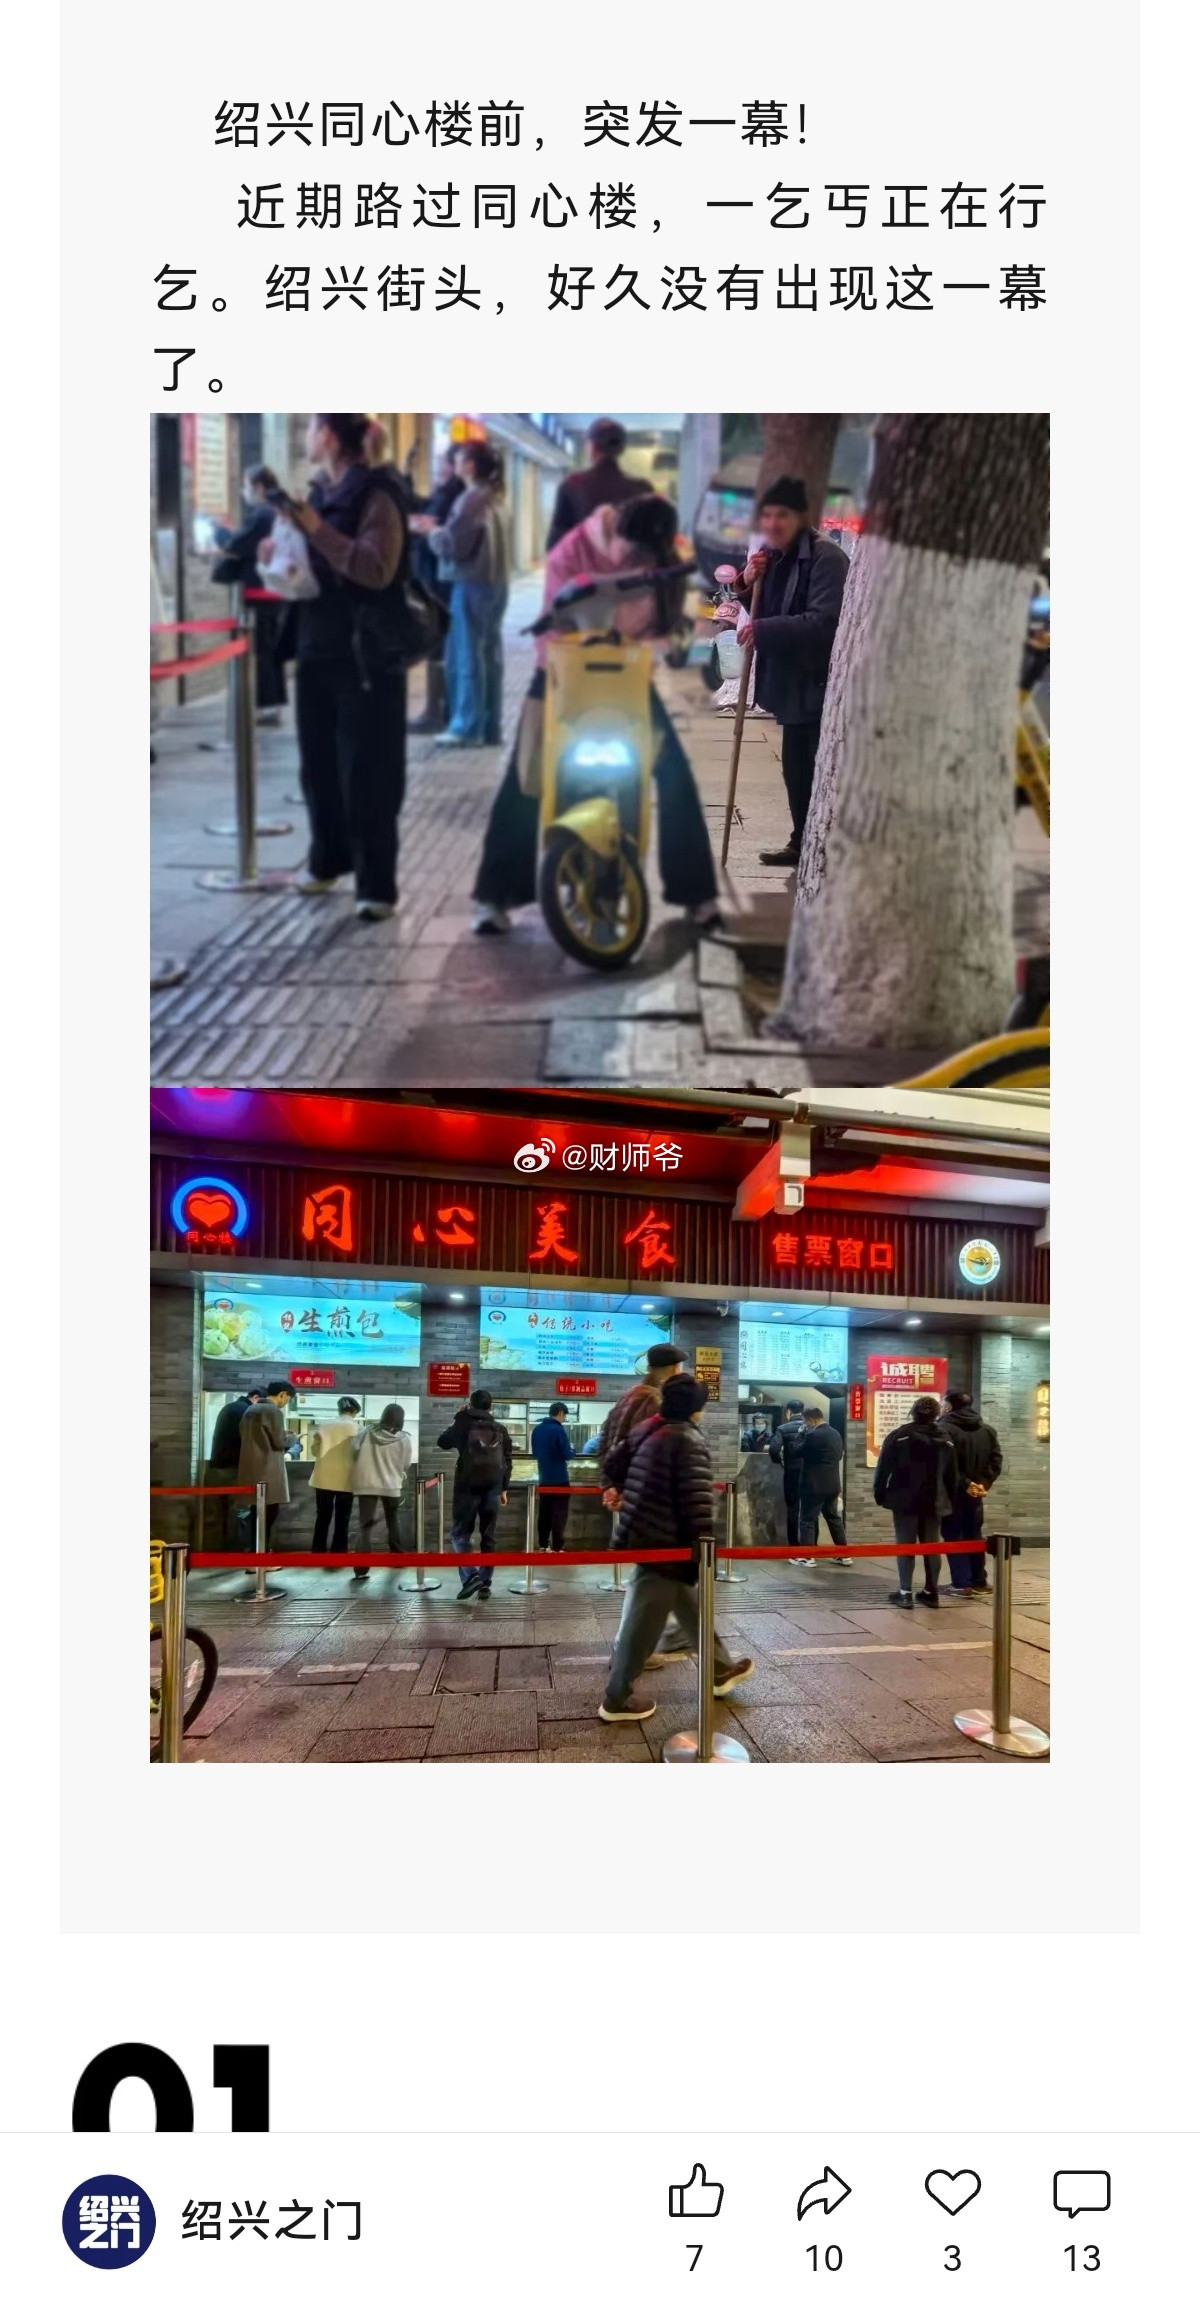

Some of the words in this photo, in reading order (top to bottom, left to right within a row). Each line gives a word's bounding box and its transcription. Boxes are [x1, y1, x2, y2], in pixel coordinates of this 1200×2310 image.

[302, 1185, 676, 1268] 同心美食
[772, 1232, 892, 1269] 售票窗口
[298, 1306, 384, 1338] 生煎包
[881, 1362, 935, 1388] 诚聘
